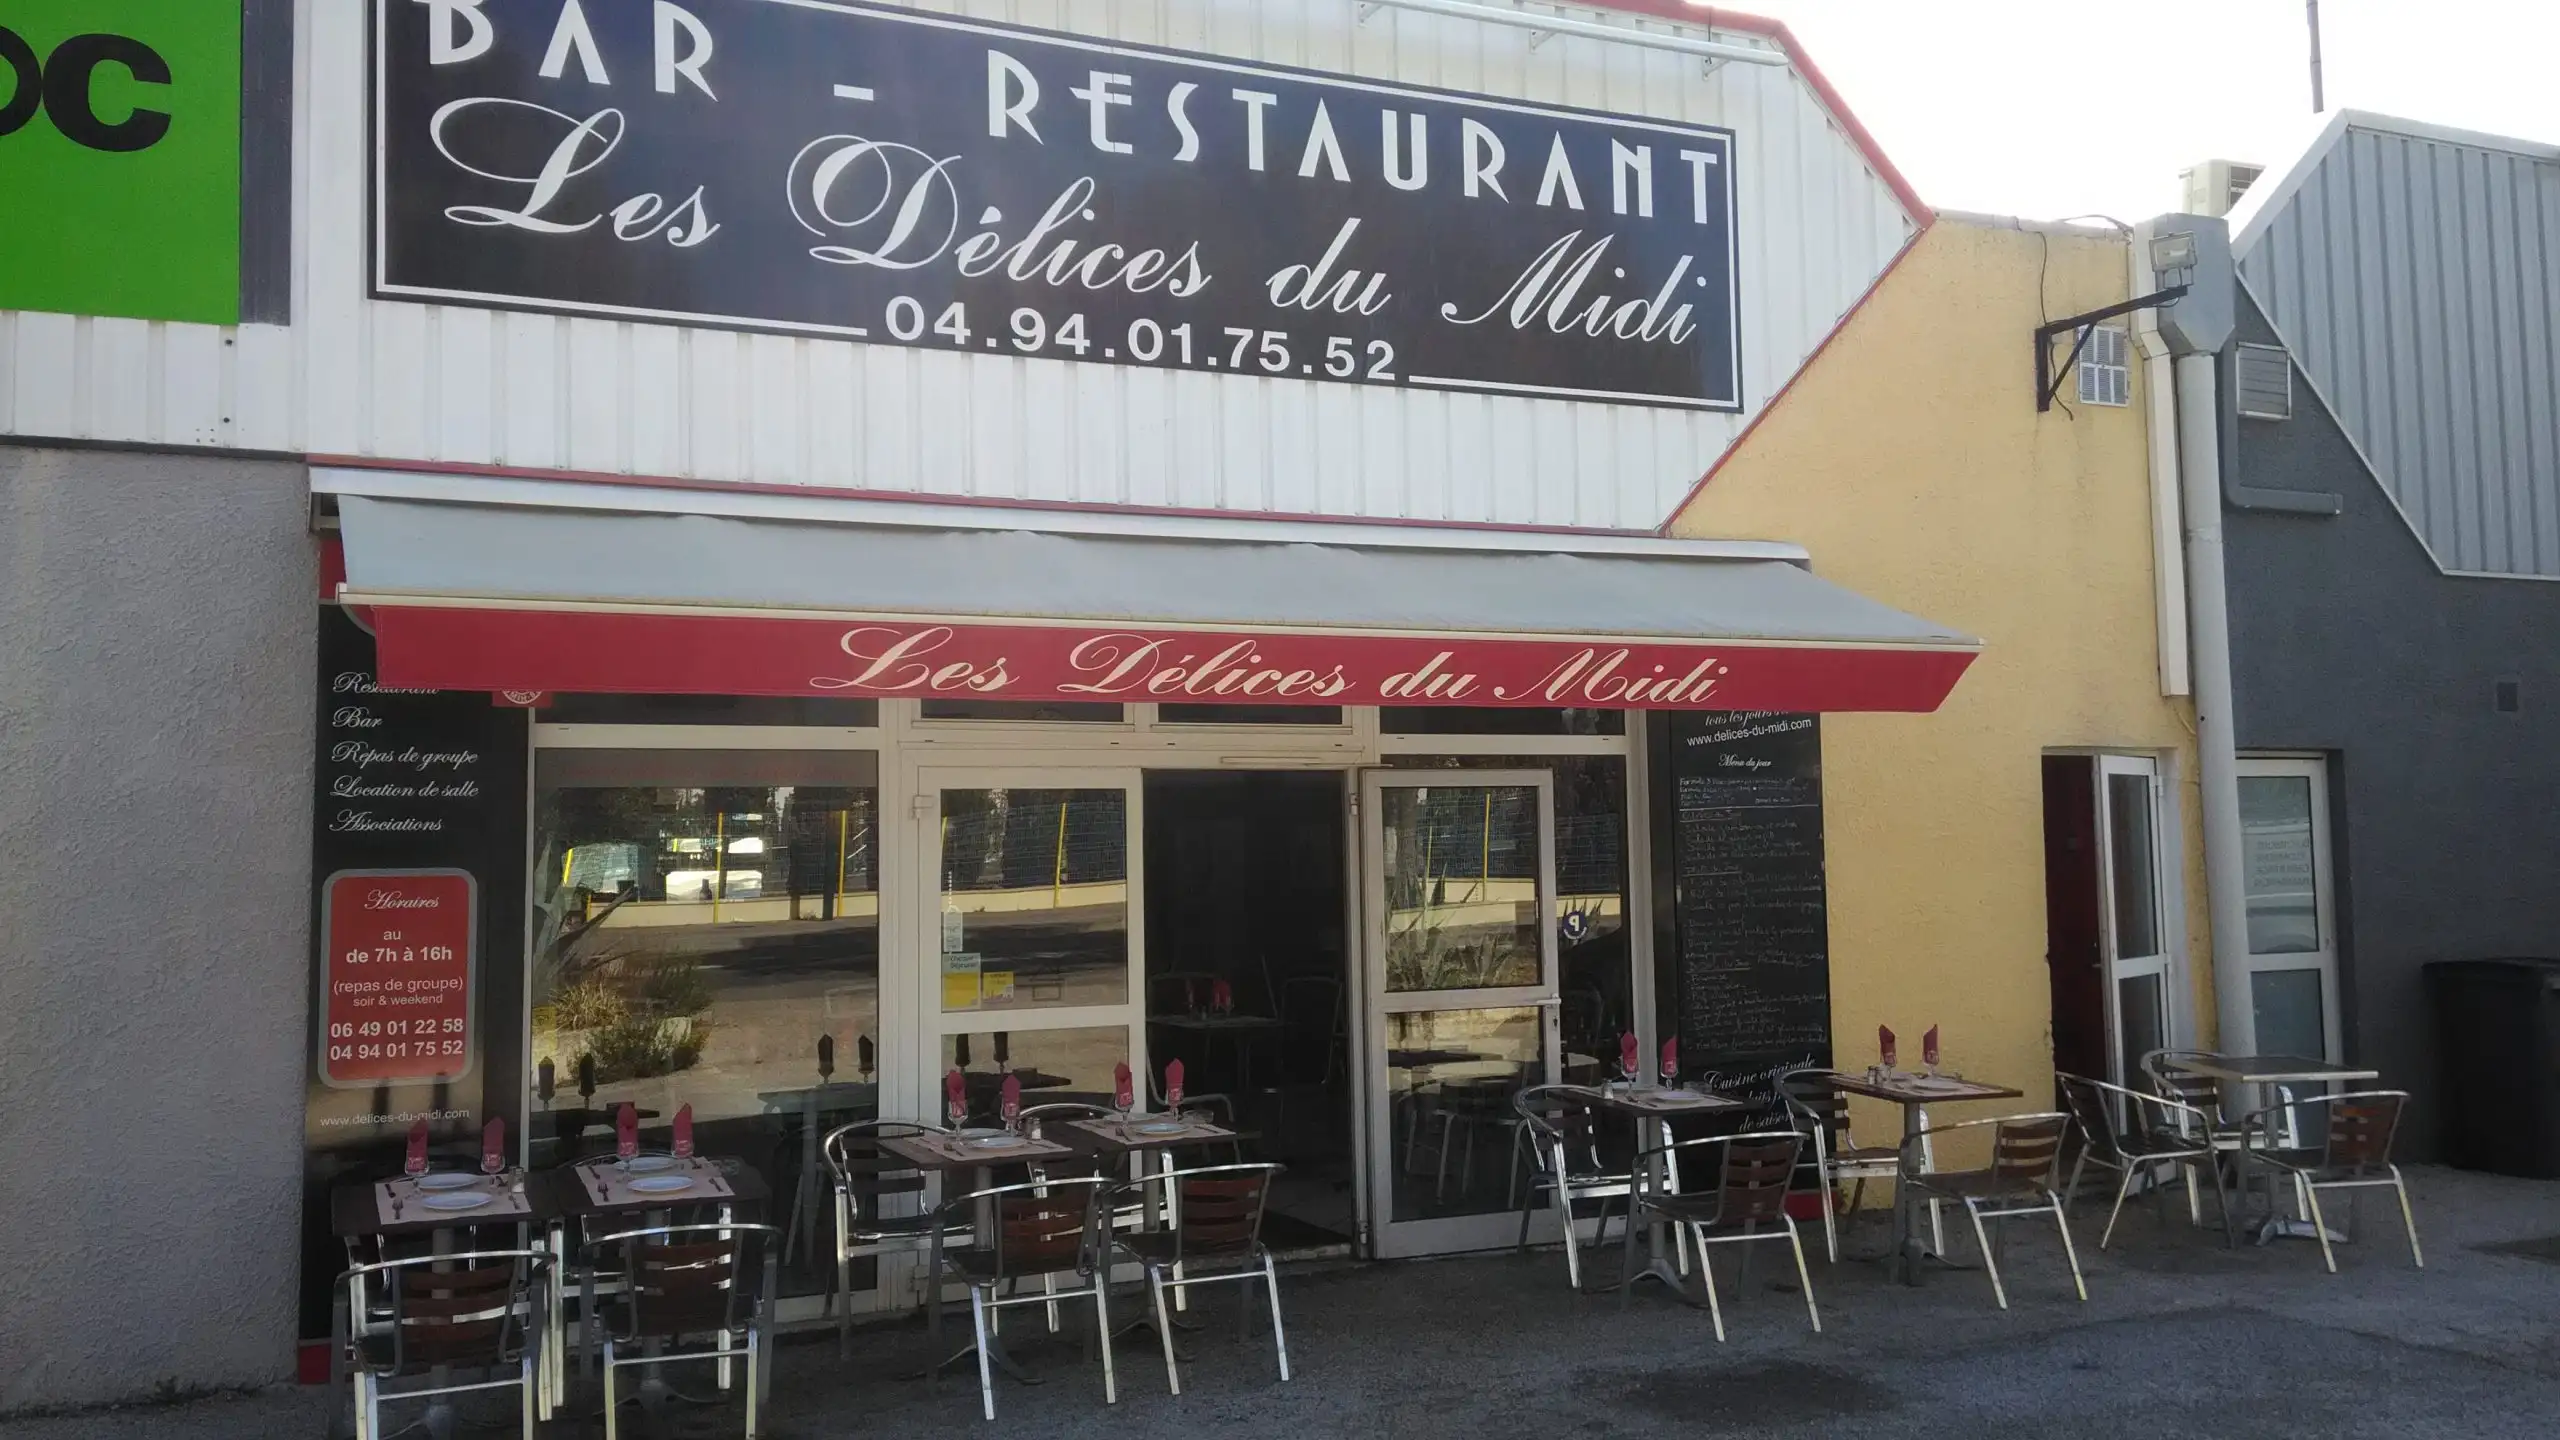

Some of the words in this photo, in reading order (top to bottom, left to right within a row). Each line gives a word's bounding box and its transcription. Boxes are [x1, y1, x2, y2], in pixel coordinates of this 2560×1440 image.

[413, 0, 719, 102] BAR
[987, 50, 1718, 224] RESTAURANT
[430, 97, 720, 247] Les
[786, 134, 1212, 298] Délices
[1266, 218, 1391, 316] du
[1442, 229, 1708, 345] Midi
[885, 295, 1396, 381] 04.94.01.75.52
[809, 626, 1020, 692] Les
[1056, 632, 1356, 696] Délices
[1379, 651, 1479, 699] du
[1493, 647, 1728, 703] Midi
[332, 706, 383, 728] Bar
[1686, 718, 1812, 747] www.delices-du-midi.com
[331, 740, 395, 769] Repas
[398, 746, 419, 763] de
[416, 750, 478, 771] groupe
[329, 774, 415, 798] Location
[418, 780, 440, 797] de
[441, 780, 479, 798] salle
[328, 808, 443, 832] Associations
[364, 889, 440, 909] Horaires
[383, 930, 402, 941] au
[345, 949, 369, 963] de
[374, 948, 397, 962] 7h
[403, 946, 414, 961] à
[420, 946, 453, 961] 16h
[333, 980, 381, 996] (repas
[384, 978, 403, 991] de
[407, 976, 463, 993] groupe)
[353, 996, 375, 1007] soir
[378, 995, 388, 1006] &
[391, 994, 443, 1006] weekend
[330, 1023, 353, 1038] 06
[358, 1021, 381, 1037] 49
[387, 1020, 408, 1035] 01
[415, 1019, 437, 1034] 22
[442, 1018, 463, 1033] 58
[330, 1045, 353, 1060] 04
[358, 1044, 380, 1059] 94
[386, 1042, 407, 1058] 01
[413, 1041, 436, 1057] 75
[441, 1040, 463, 1055] 52
[1703, 1070, 1758, 1090] Cuisine
[319, 1109, 471, 1127] www.delices-du-midi.com
[1738, 1115, 1754, 1133] de
